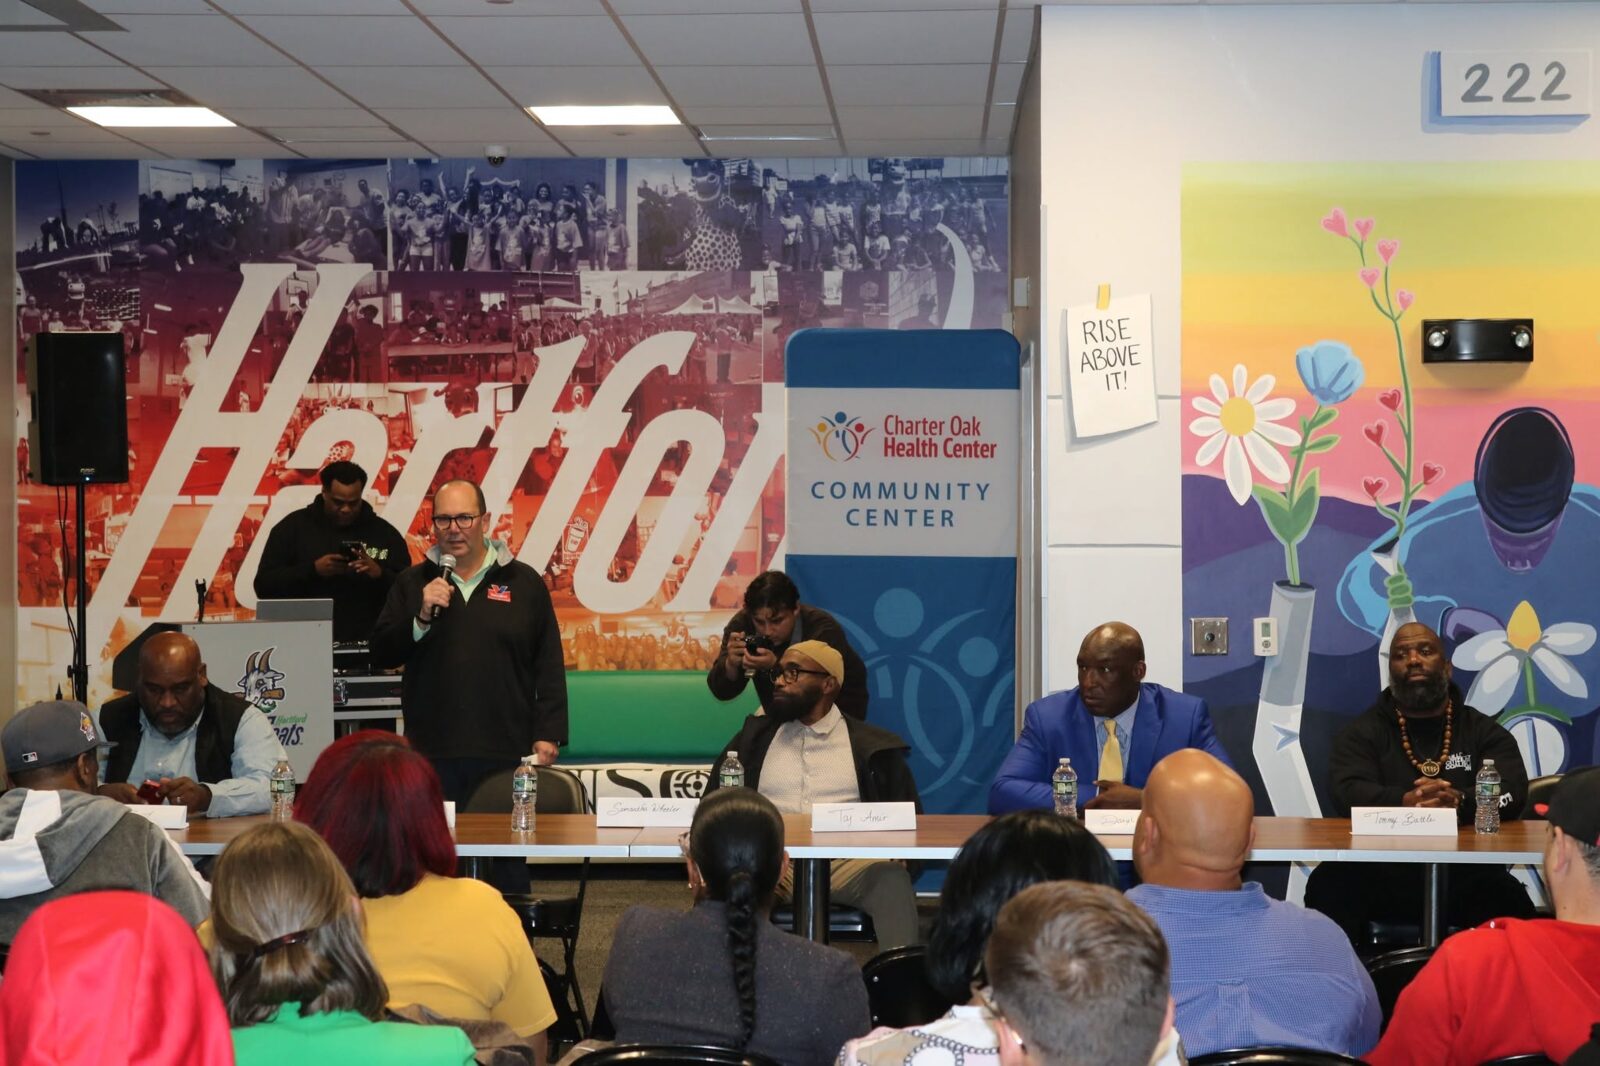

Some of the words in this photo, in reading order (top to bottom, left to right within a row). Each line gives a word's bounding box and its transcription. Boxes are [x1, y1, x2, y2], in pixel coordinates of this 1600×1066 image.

[1461, 61, 1572, 103] 222
[1082, 317, 1132, 345] RISE
[1081, 343, 1142, 374] ABOVE
[1105, 369, 1128, 392] IT!
[884, 414, 946, 437] Charter
[950, 415, 981, 437] Oak
[883, 437, 939, 459] Health
[943, 438, 998, 460] Center
[811, 481, 991, 501] COMMUNITY
[846, 508, 955, 528] CENTER
